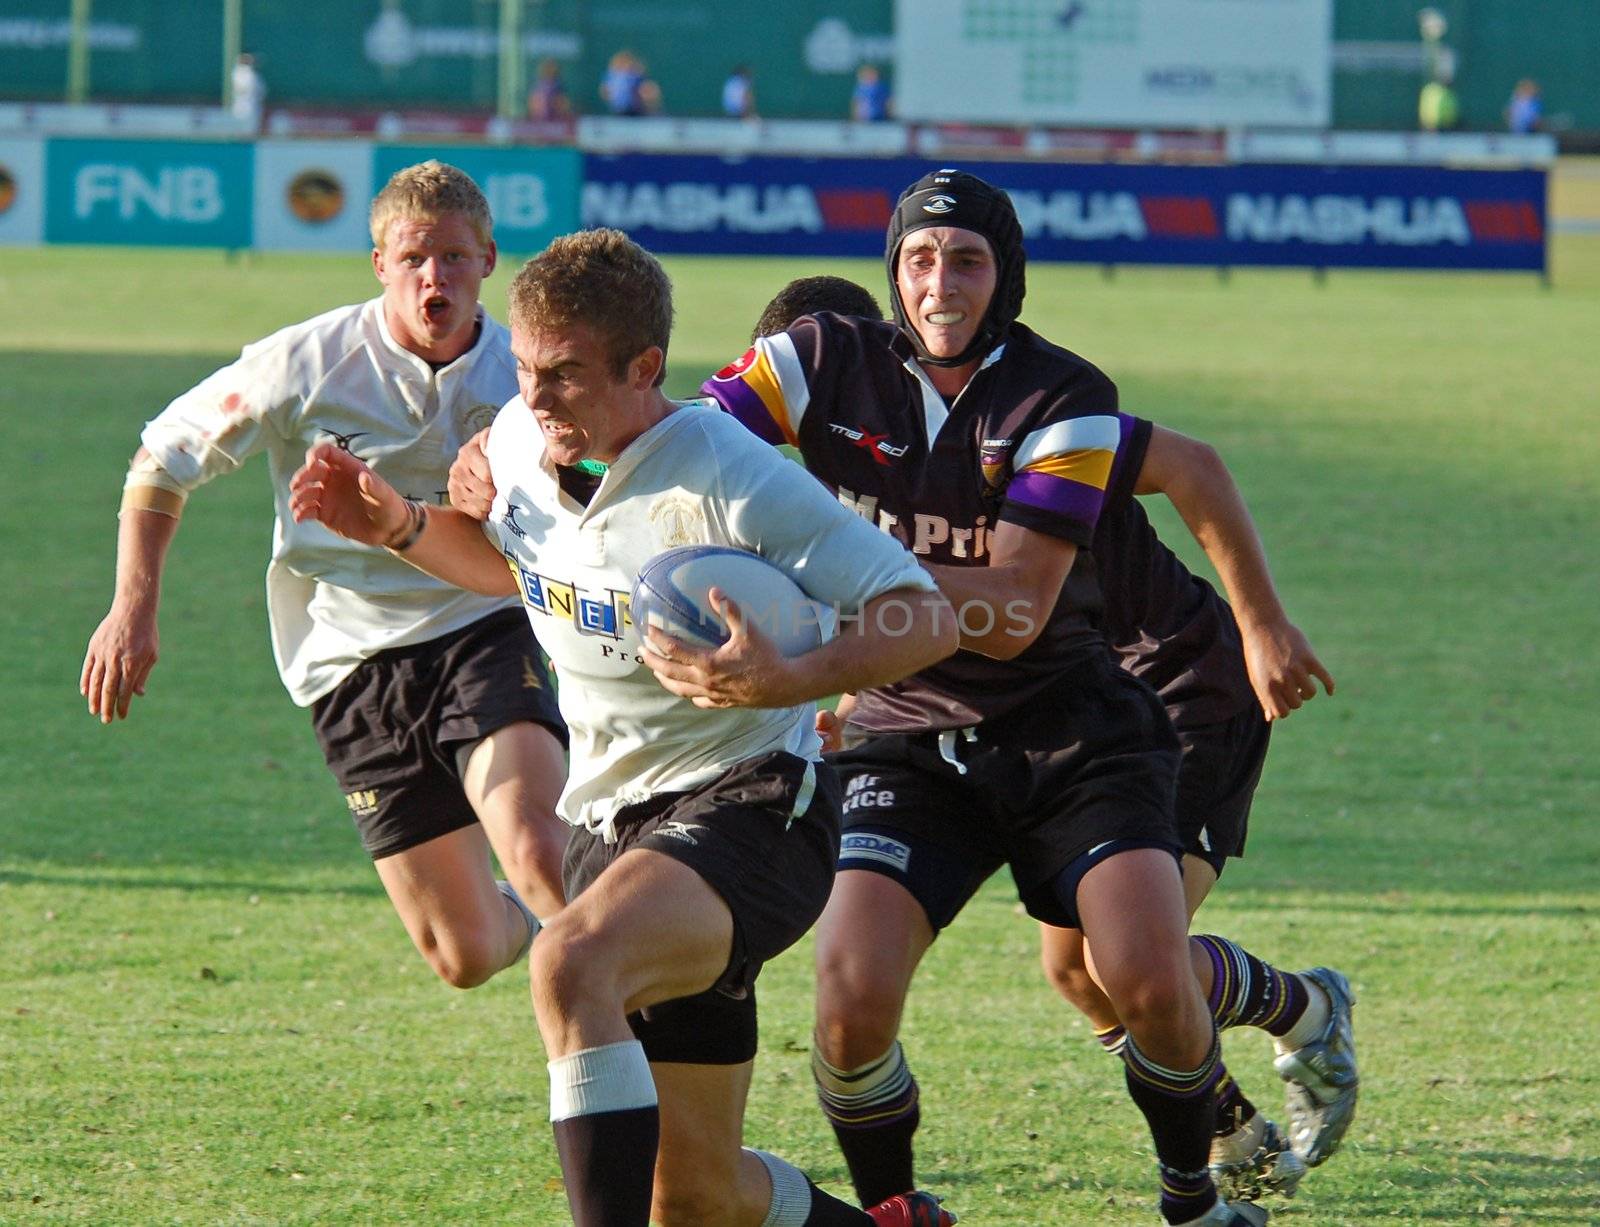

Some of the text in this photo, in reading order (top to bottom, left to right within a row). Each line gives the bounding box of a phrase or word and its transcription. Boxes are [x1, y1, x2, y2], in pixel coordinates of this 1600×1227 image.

[75, 164, 224, 221] FNB
[582, 183, 823, 235] NASHUA
[1227, 193, 1470, 246] NASHUA
